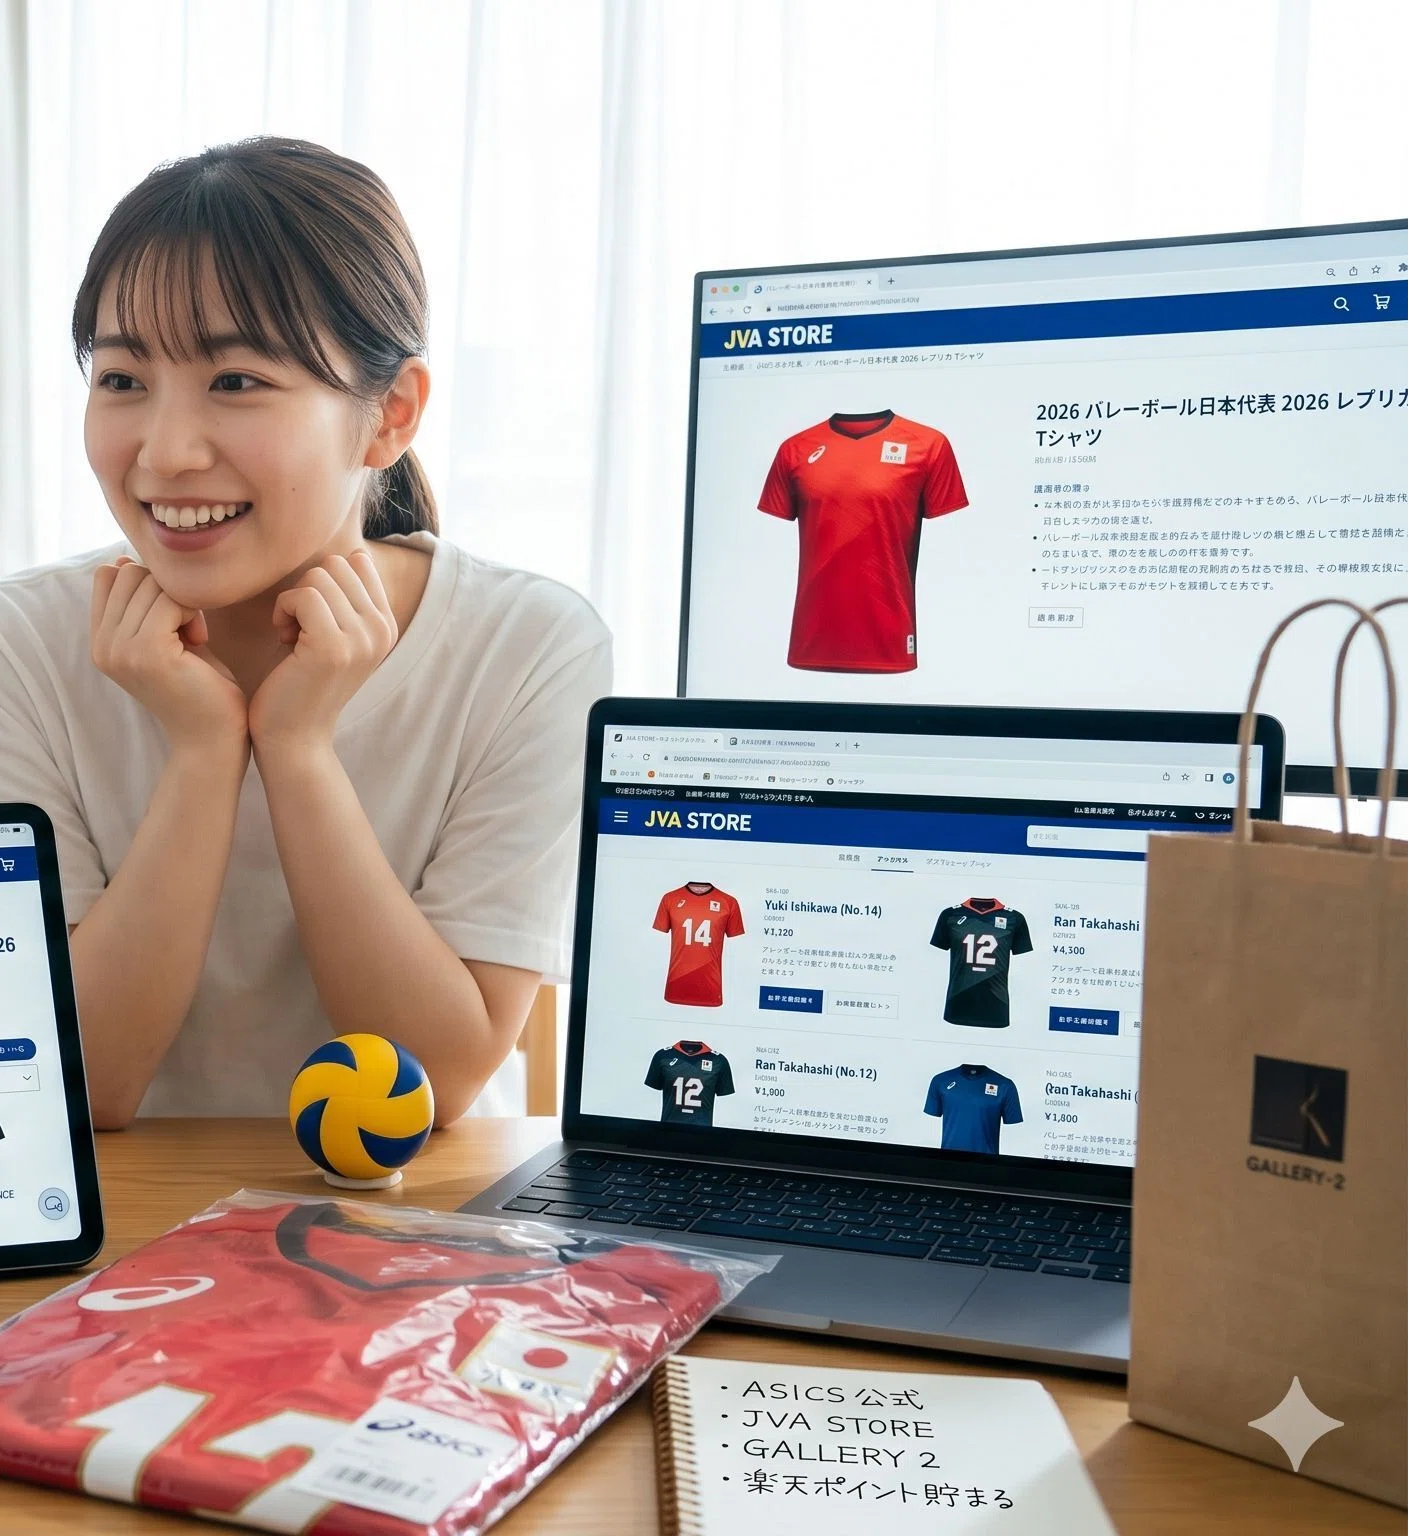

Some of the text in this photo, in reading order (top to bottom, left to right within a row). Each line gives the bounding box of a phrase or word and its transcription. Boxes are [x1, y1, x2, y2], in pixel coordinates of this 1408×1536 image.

[724, 324, 833, 350] JVA STORE
[1036, 402, 1080, 421] 2026
[1085, 393, 1276, 419] バレーボール日本代表
[1282, 392, 1330, 411] 2026
[1035, 428, 1103, 448] Tシャツ
[644, 810, 752, 832] JVA STORE
[765, 900, 883, 919] Yuki Ishikawa (No.14)
[682, 918, 713, 947] 14
[1054, 917, 1140, 932] Ran Takahashi
[963, 934, 999, 966] 12
[755, 1059, 877, 1082] Ran Takahashi (No.12)
[672, 1076, 704, 1108] 12
[1070, 1084, 1132, 1101] Takahashi
[742, 1380, 924, 1411] ASICS 公式
[742, 1409, 935, 1438] JVA STORE
[743, 1439, 940, 1469] GALLERY 2
[743, 1468, 1014, 1510] 楽天ポイント貯まる
